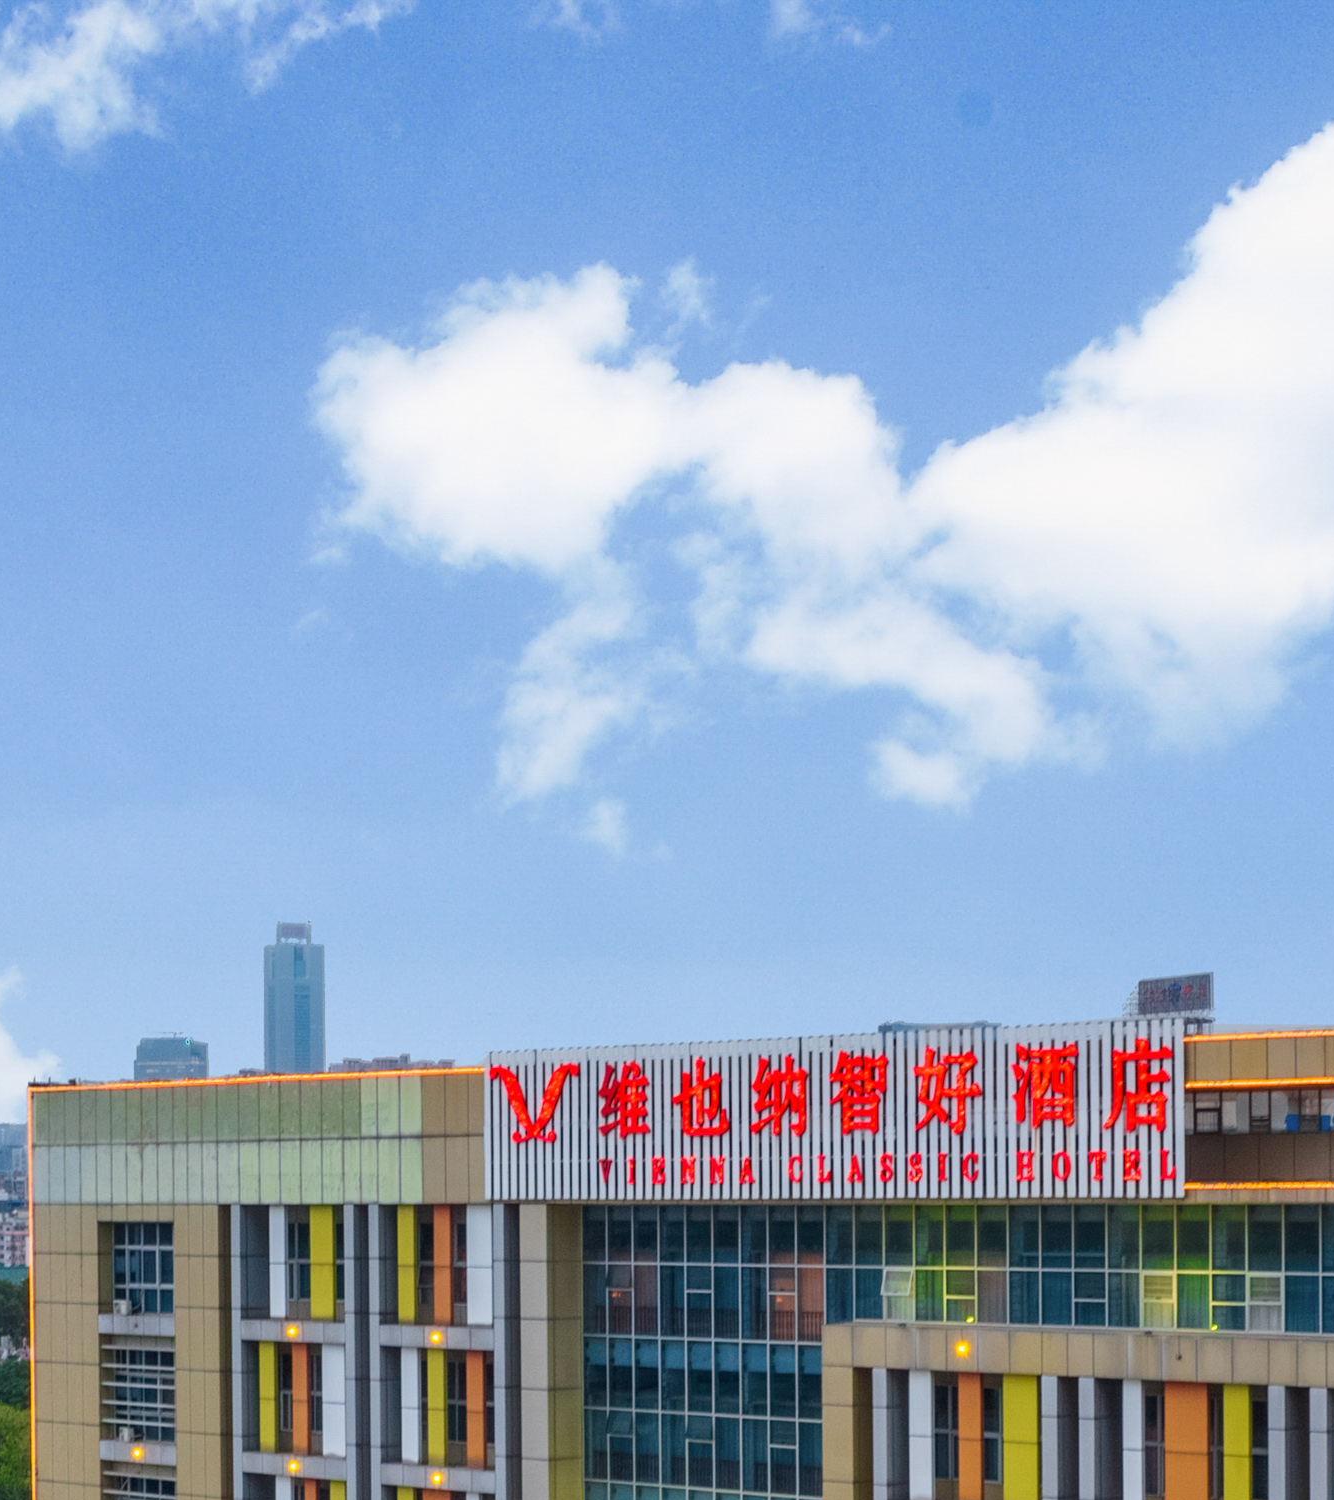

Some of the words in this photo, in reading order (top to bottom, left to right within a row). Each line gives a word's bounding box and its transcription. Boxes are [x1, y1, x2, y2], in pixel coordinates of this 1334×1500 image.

[598, 1037, 1174, 1139] 维也纳智好酒店
[598, 1154, 756, 1185] VIENNA
[788, 1151, 979, 1185] CLASSIC
[1016, 1147, 1177, 1183] HOTEL
